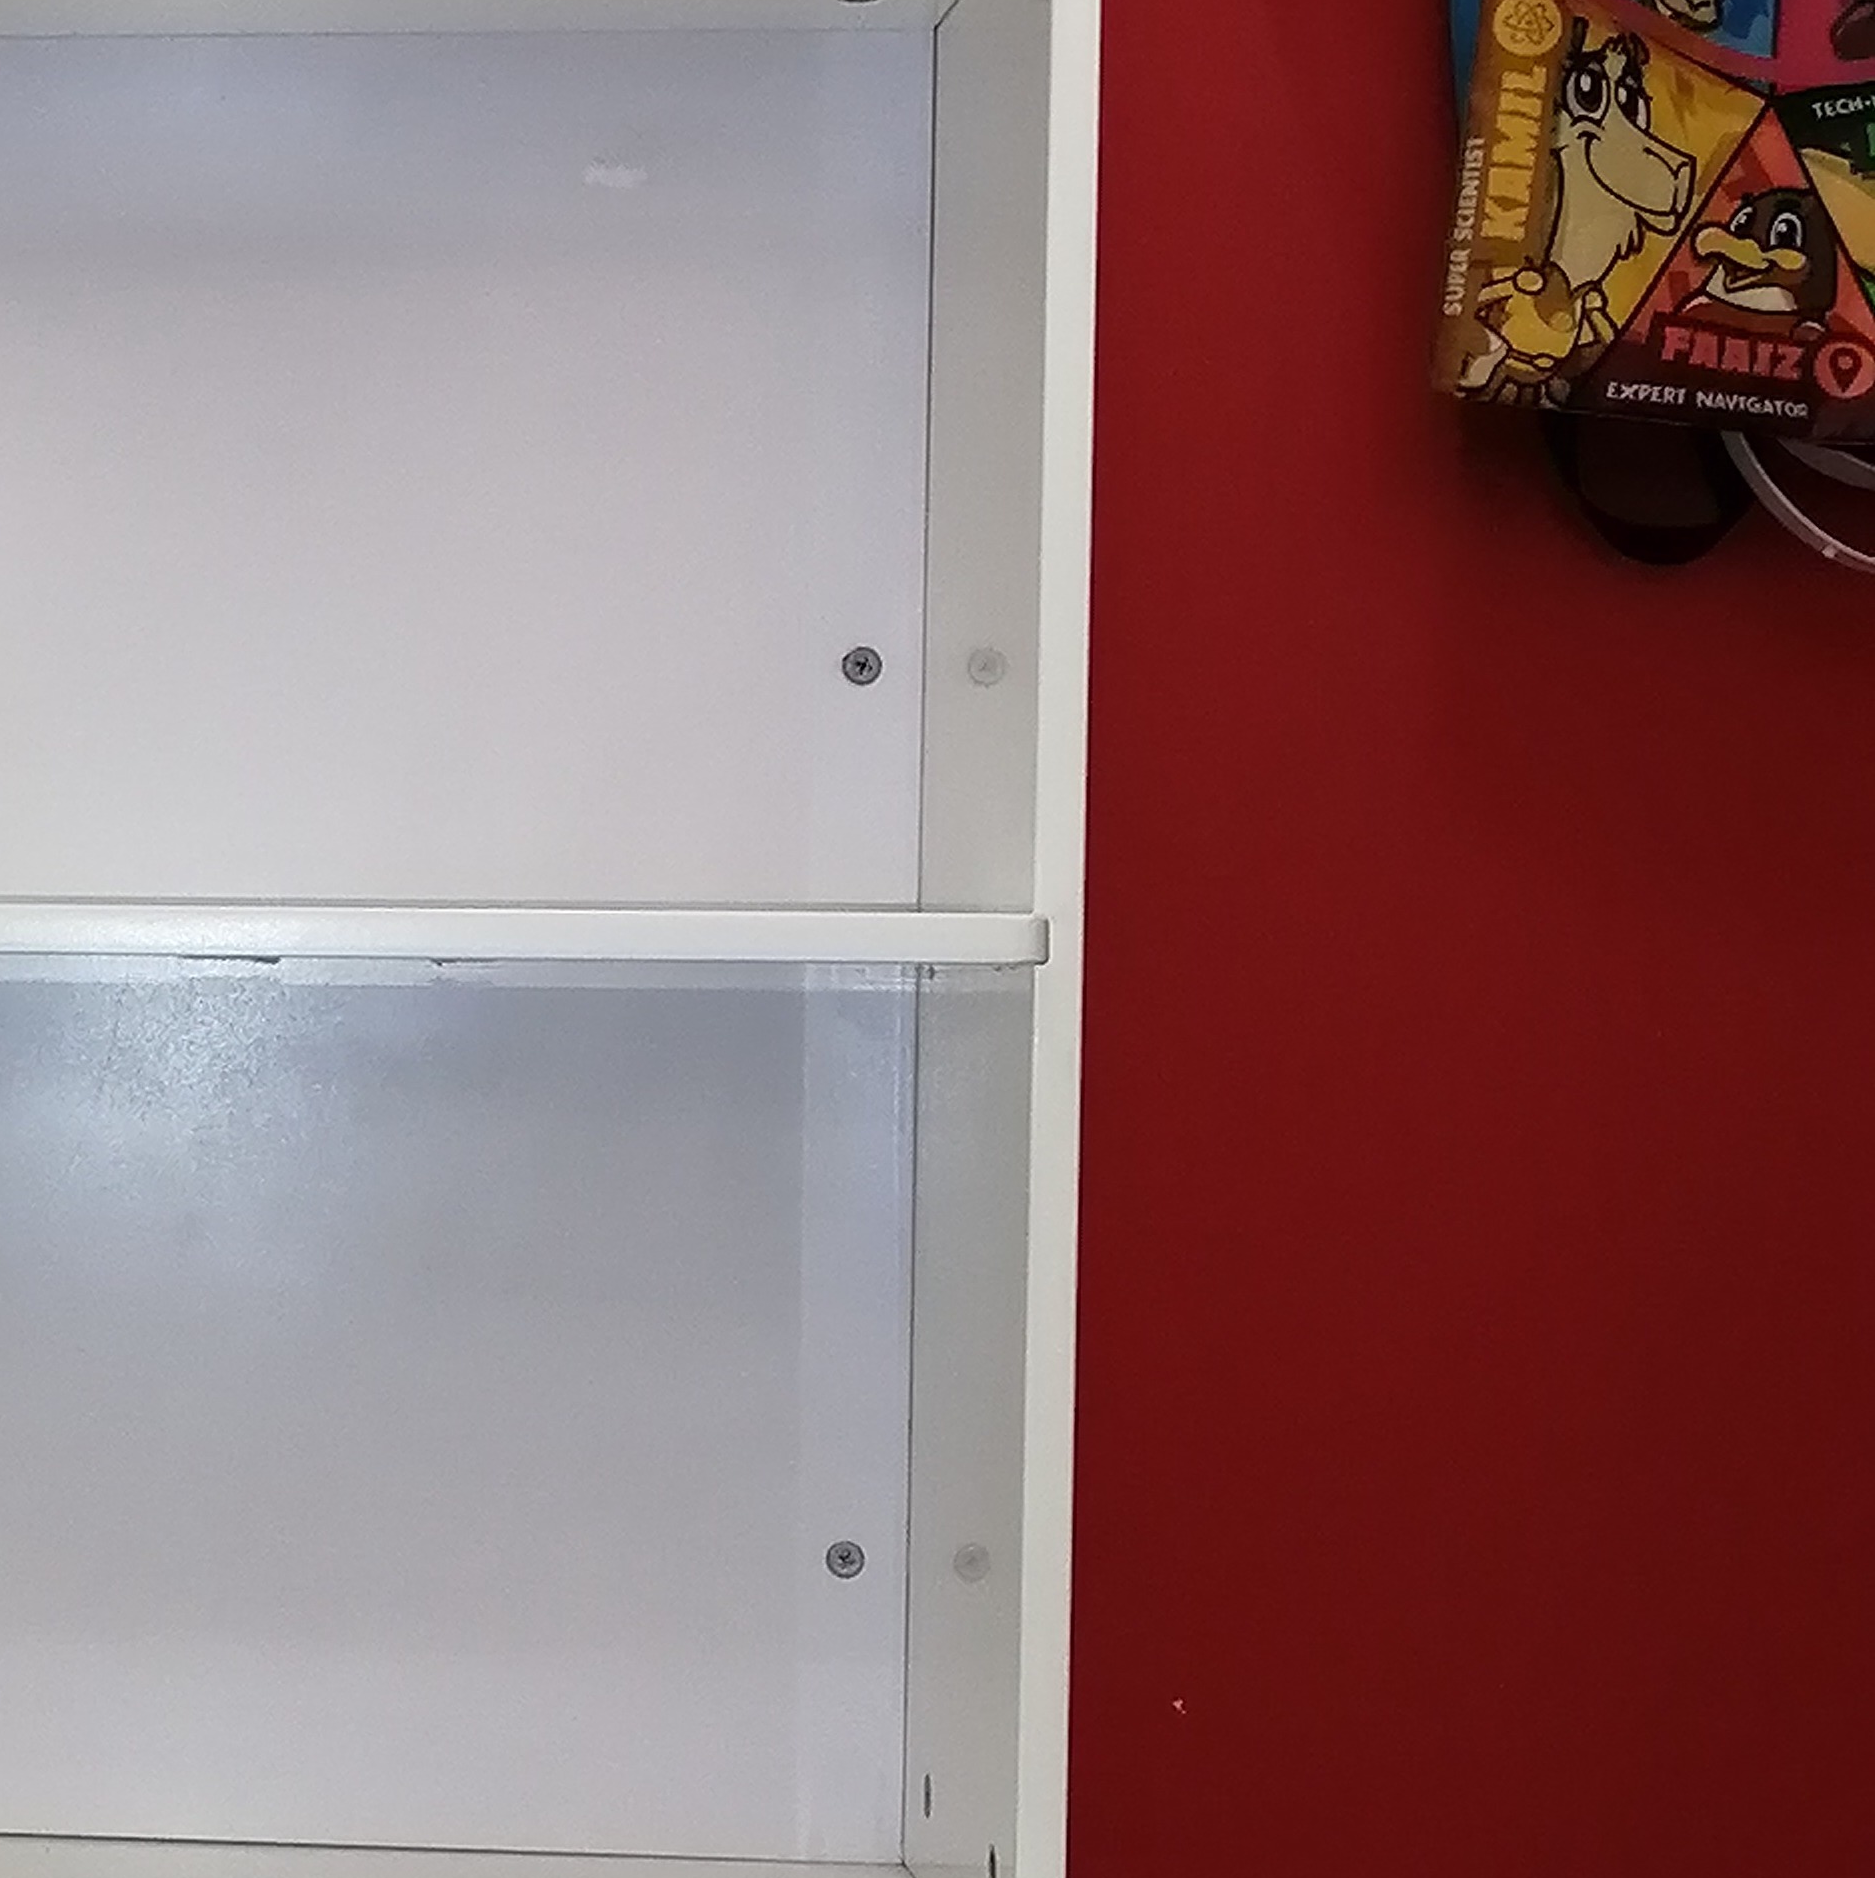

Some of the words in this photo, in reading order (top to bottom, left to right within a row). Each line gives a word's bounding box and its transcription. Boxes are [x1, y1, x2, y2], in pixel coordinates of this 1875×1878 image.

[1480, 64, 1547, 242] KAMIL
[1454, 136, 1486, 243] SCIENTIST
[1442, 248, 1473, 317] SUPER
[1661, 326, 1806, 381] FAAIZ
[1606, 381, 1687, 405] EXPERT
[1696, 390, 1810, 418] NAVIGATOR
